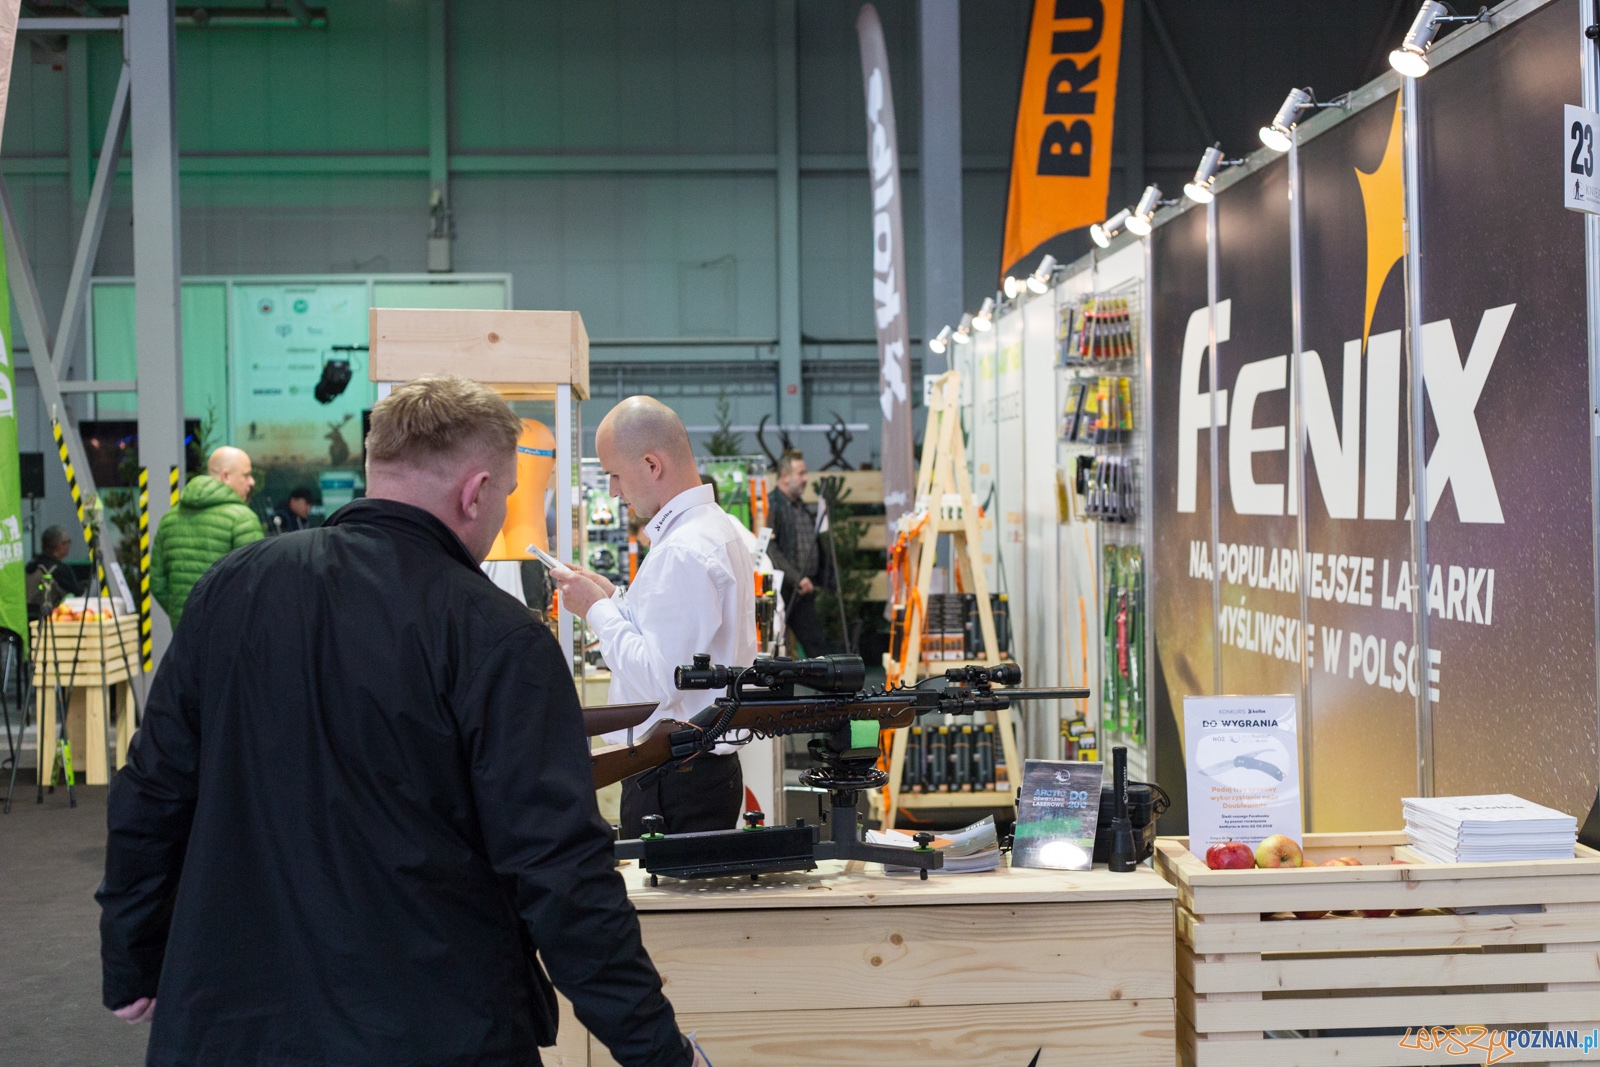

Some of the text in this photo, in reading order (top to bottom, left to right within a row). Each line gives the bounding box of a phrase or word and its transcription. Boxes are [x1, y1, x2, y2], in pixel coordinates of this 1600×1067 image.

[1571, 121, 1594, 178] 23
[1381, 558, 1495, 626] LAARKI
[1321, 625, 1343, 675] W
[1348, 631, 1442, 703] POLSCE
[1202, 719, 1279, 728] DO WYGRANIA
[1033, 788, 1089, 801] ARCTIC DO
[1211, 786, 1232, 794] Podaj
